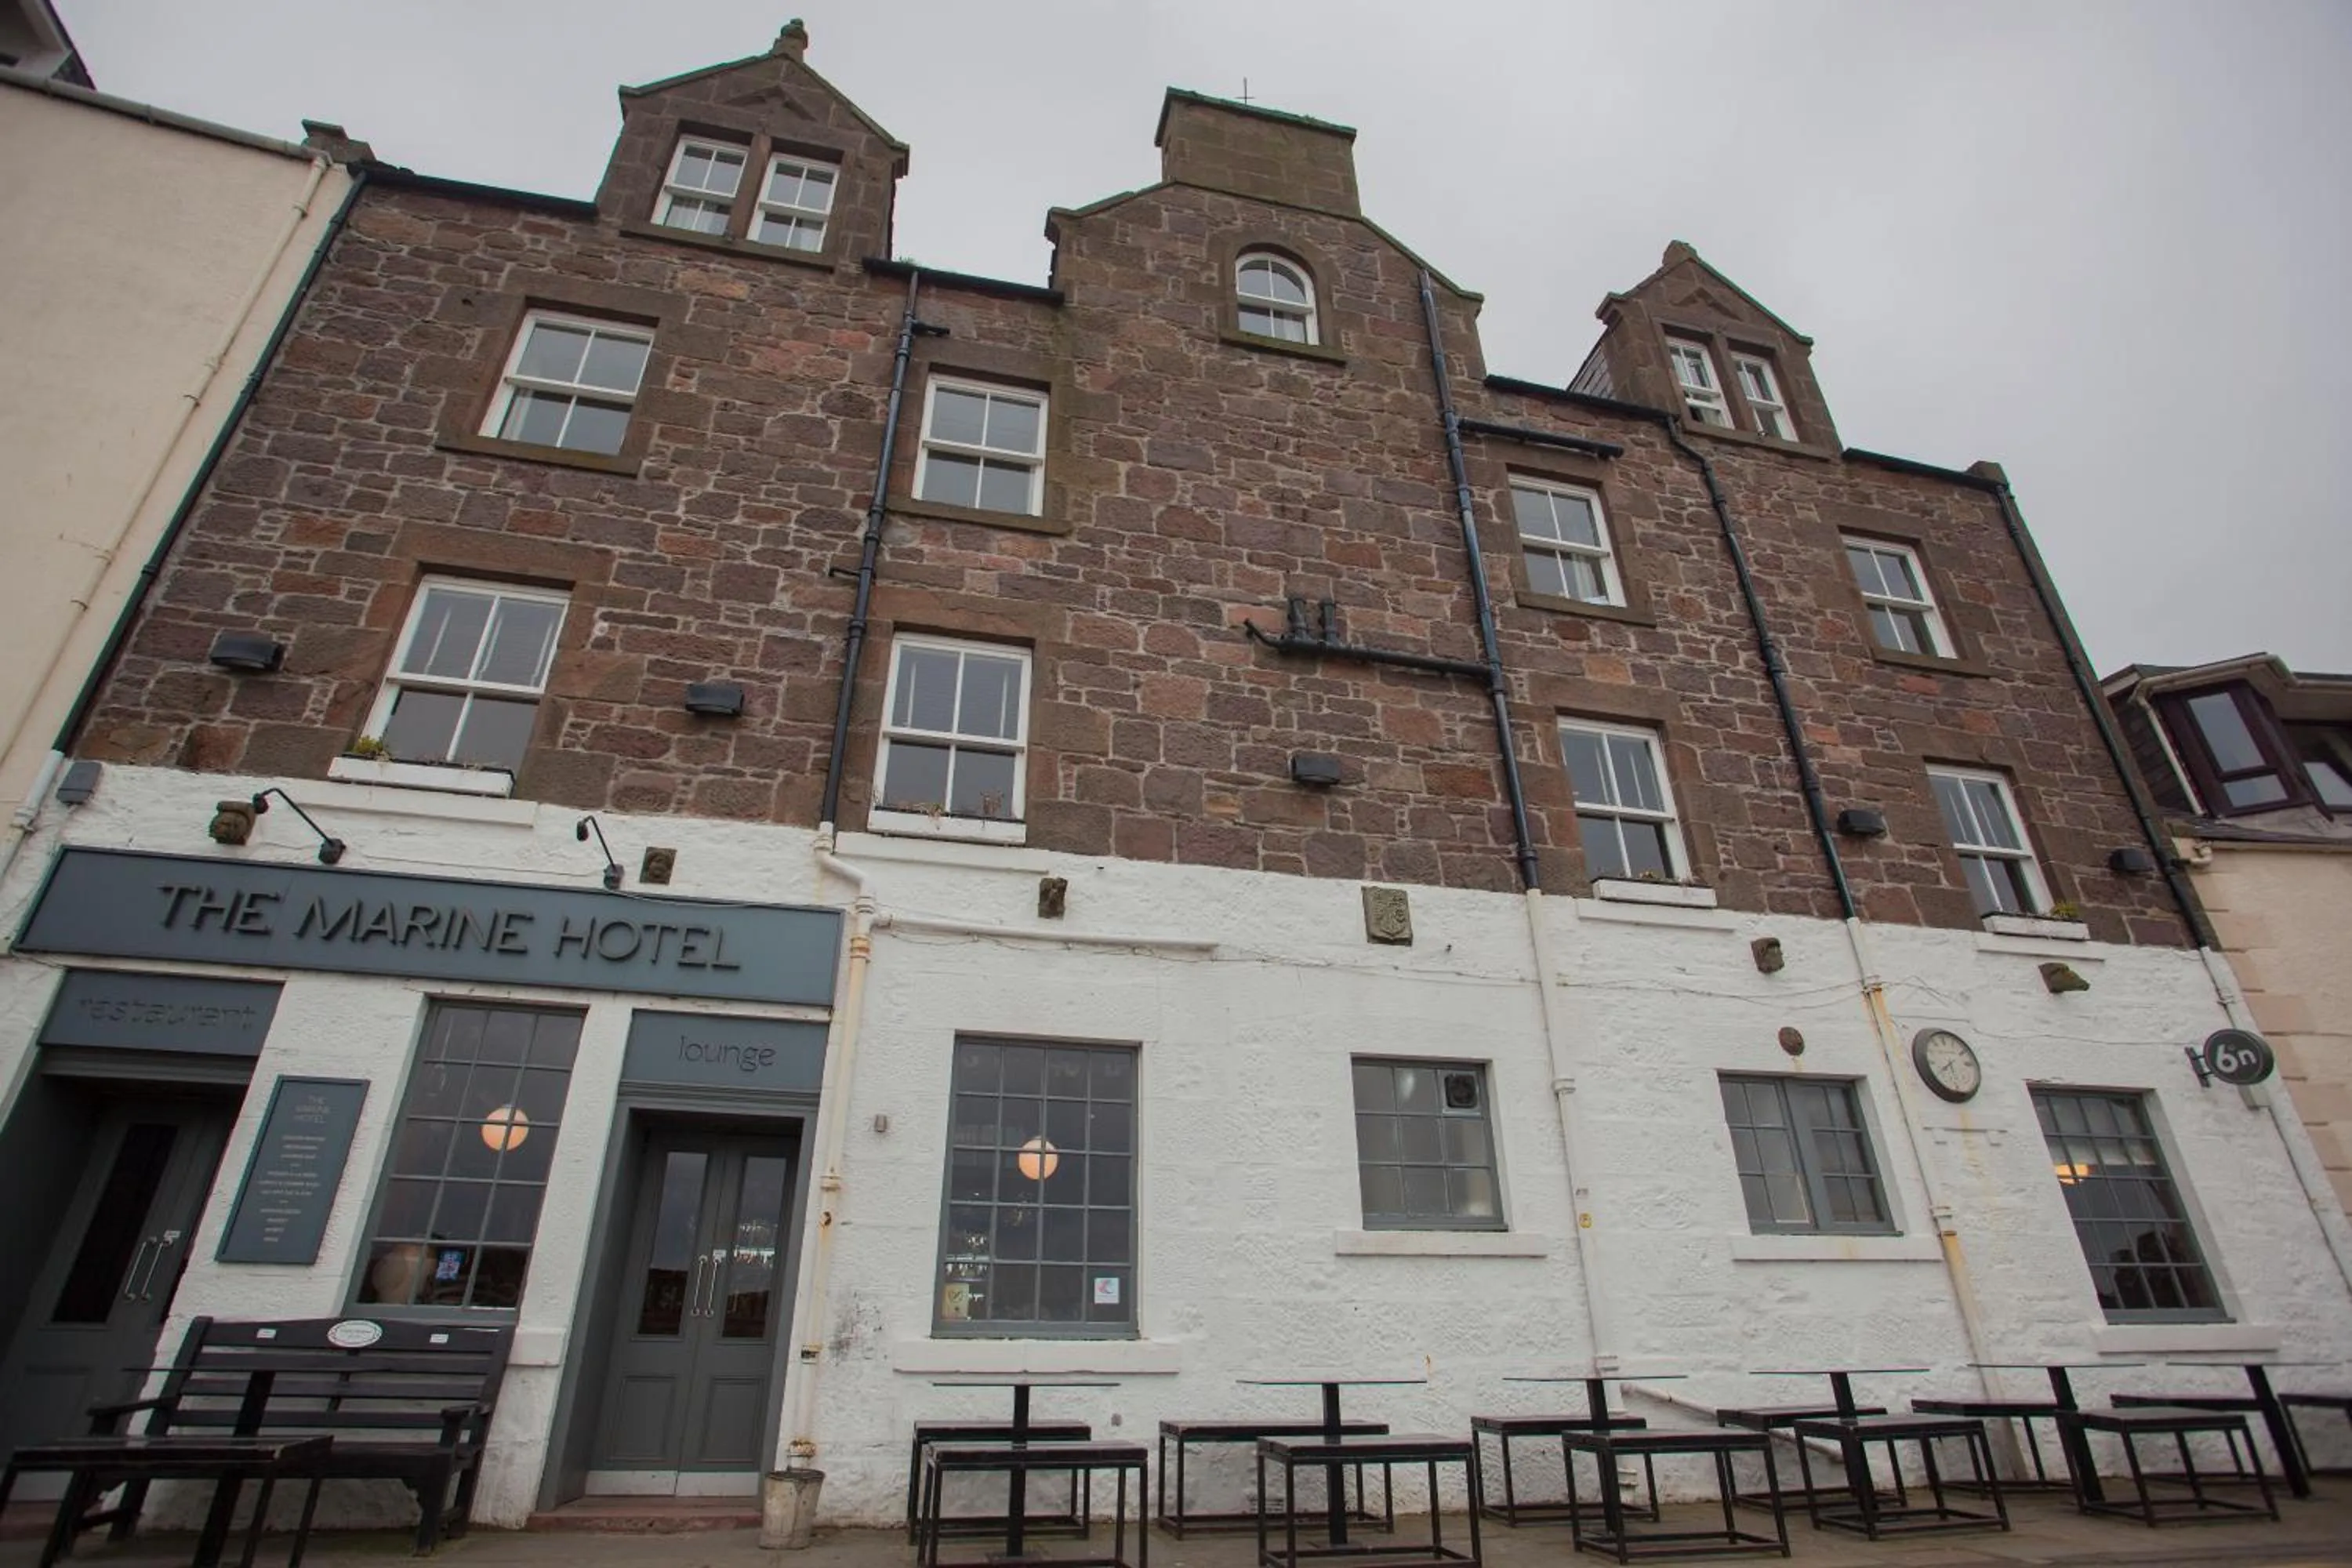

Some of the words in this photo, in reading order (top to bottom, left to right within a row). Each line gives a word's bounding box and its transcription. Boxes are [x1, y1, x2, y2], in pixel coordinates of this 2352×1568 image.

[159, 886, 281, 936] THE
[295, 895, 535, 955] MARINE
[554, 915, 741, 971] HOTEL
[678, 1034, 778, 1073] lounge
